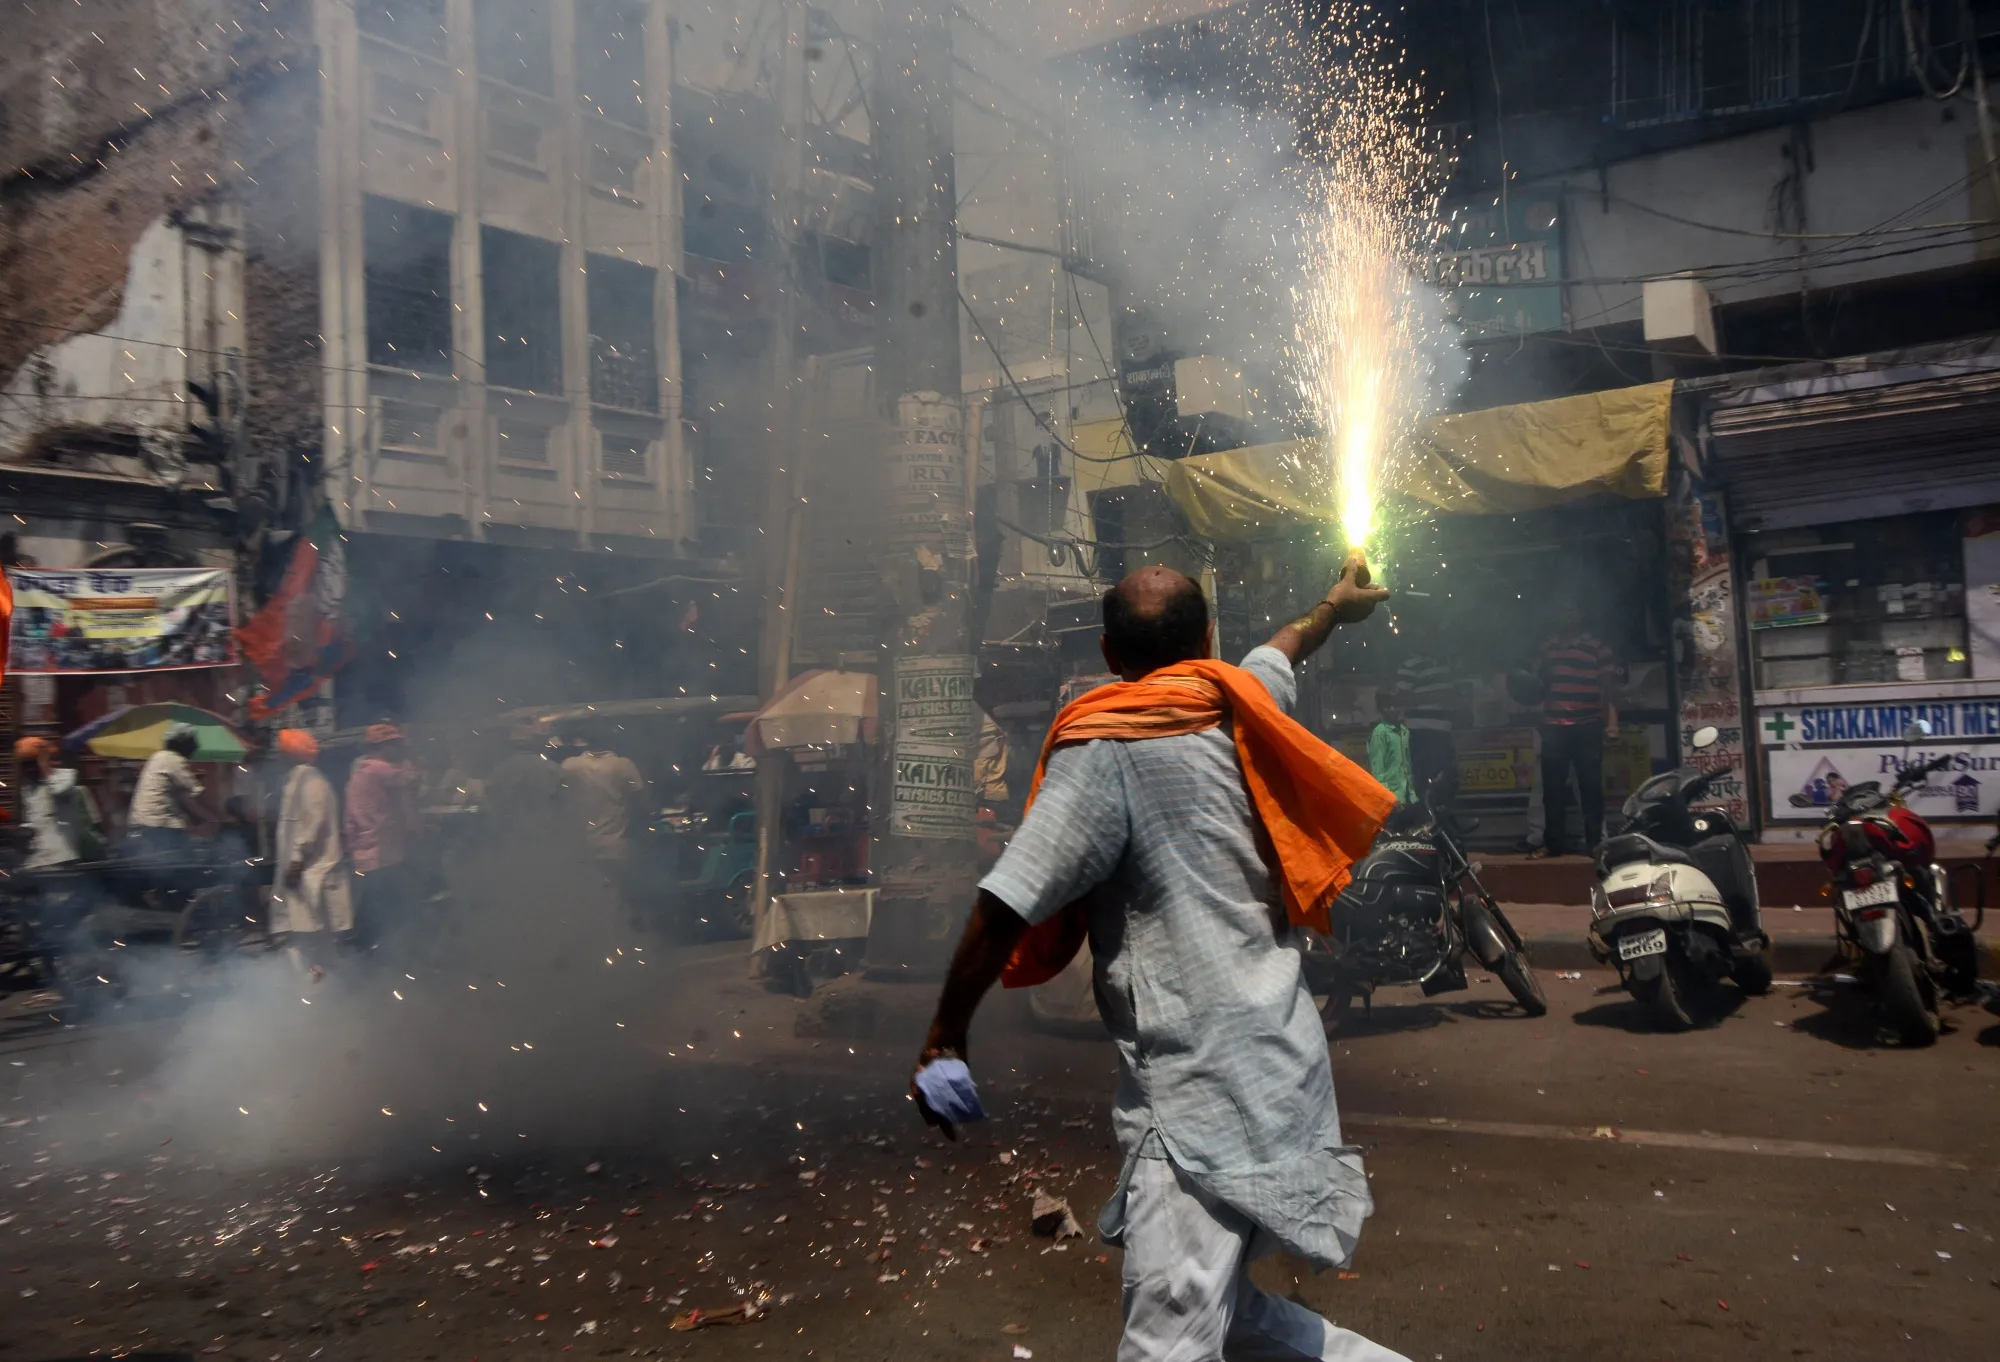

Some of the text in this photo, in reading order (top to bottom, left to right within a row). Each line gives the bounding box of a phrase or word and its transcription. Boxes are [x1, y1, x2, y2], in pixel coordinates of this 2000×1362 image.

[900, 701, 949, 717] PHYSICS
[1961, 702, 2000, 736] ME
[896, 786, 944, 805] PHYSICS
